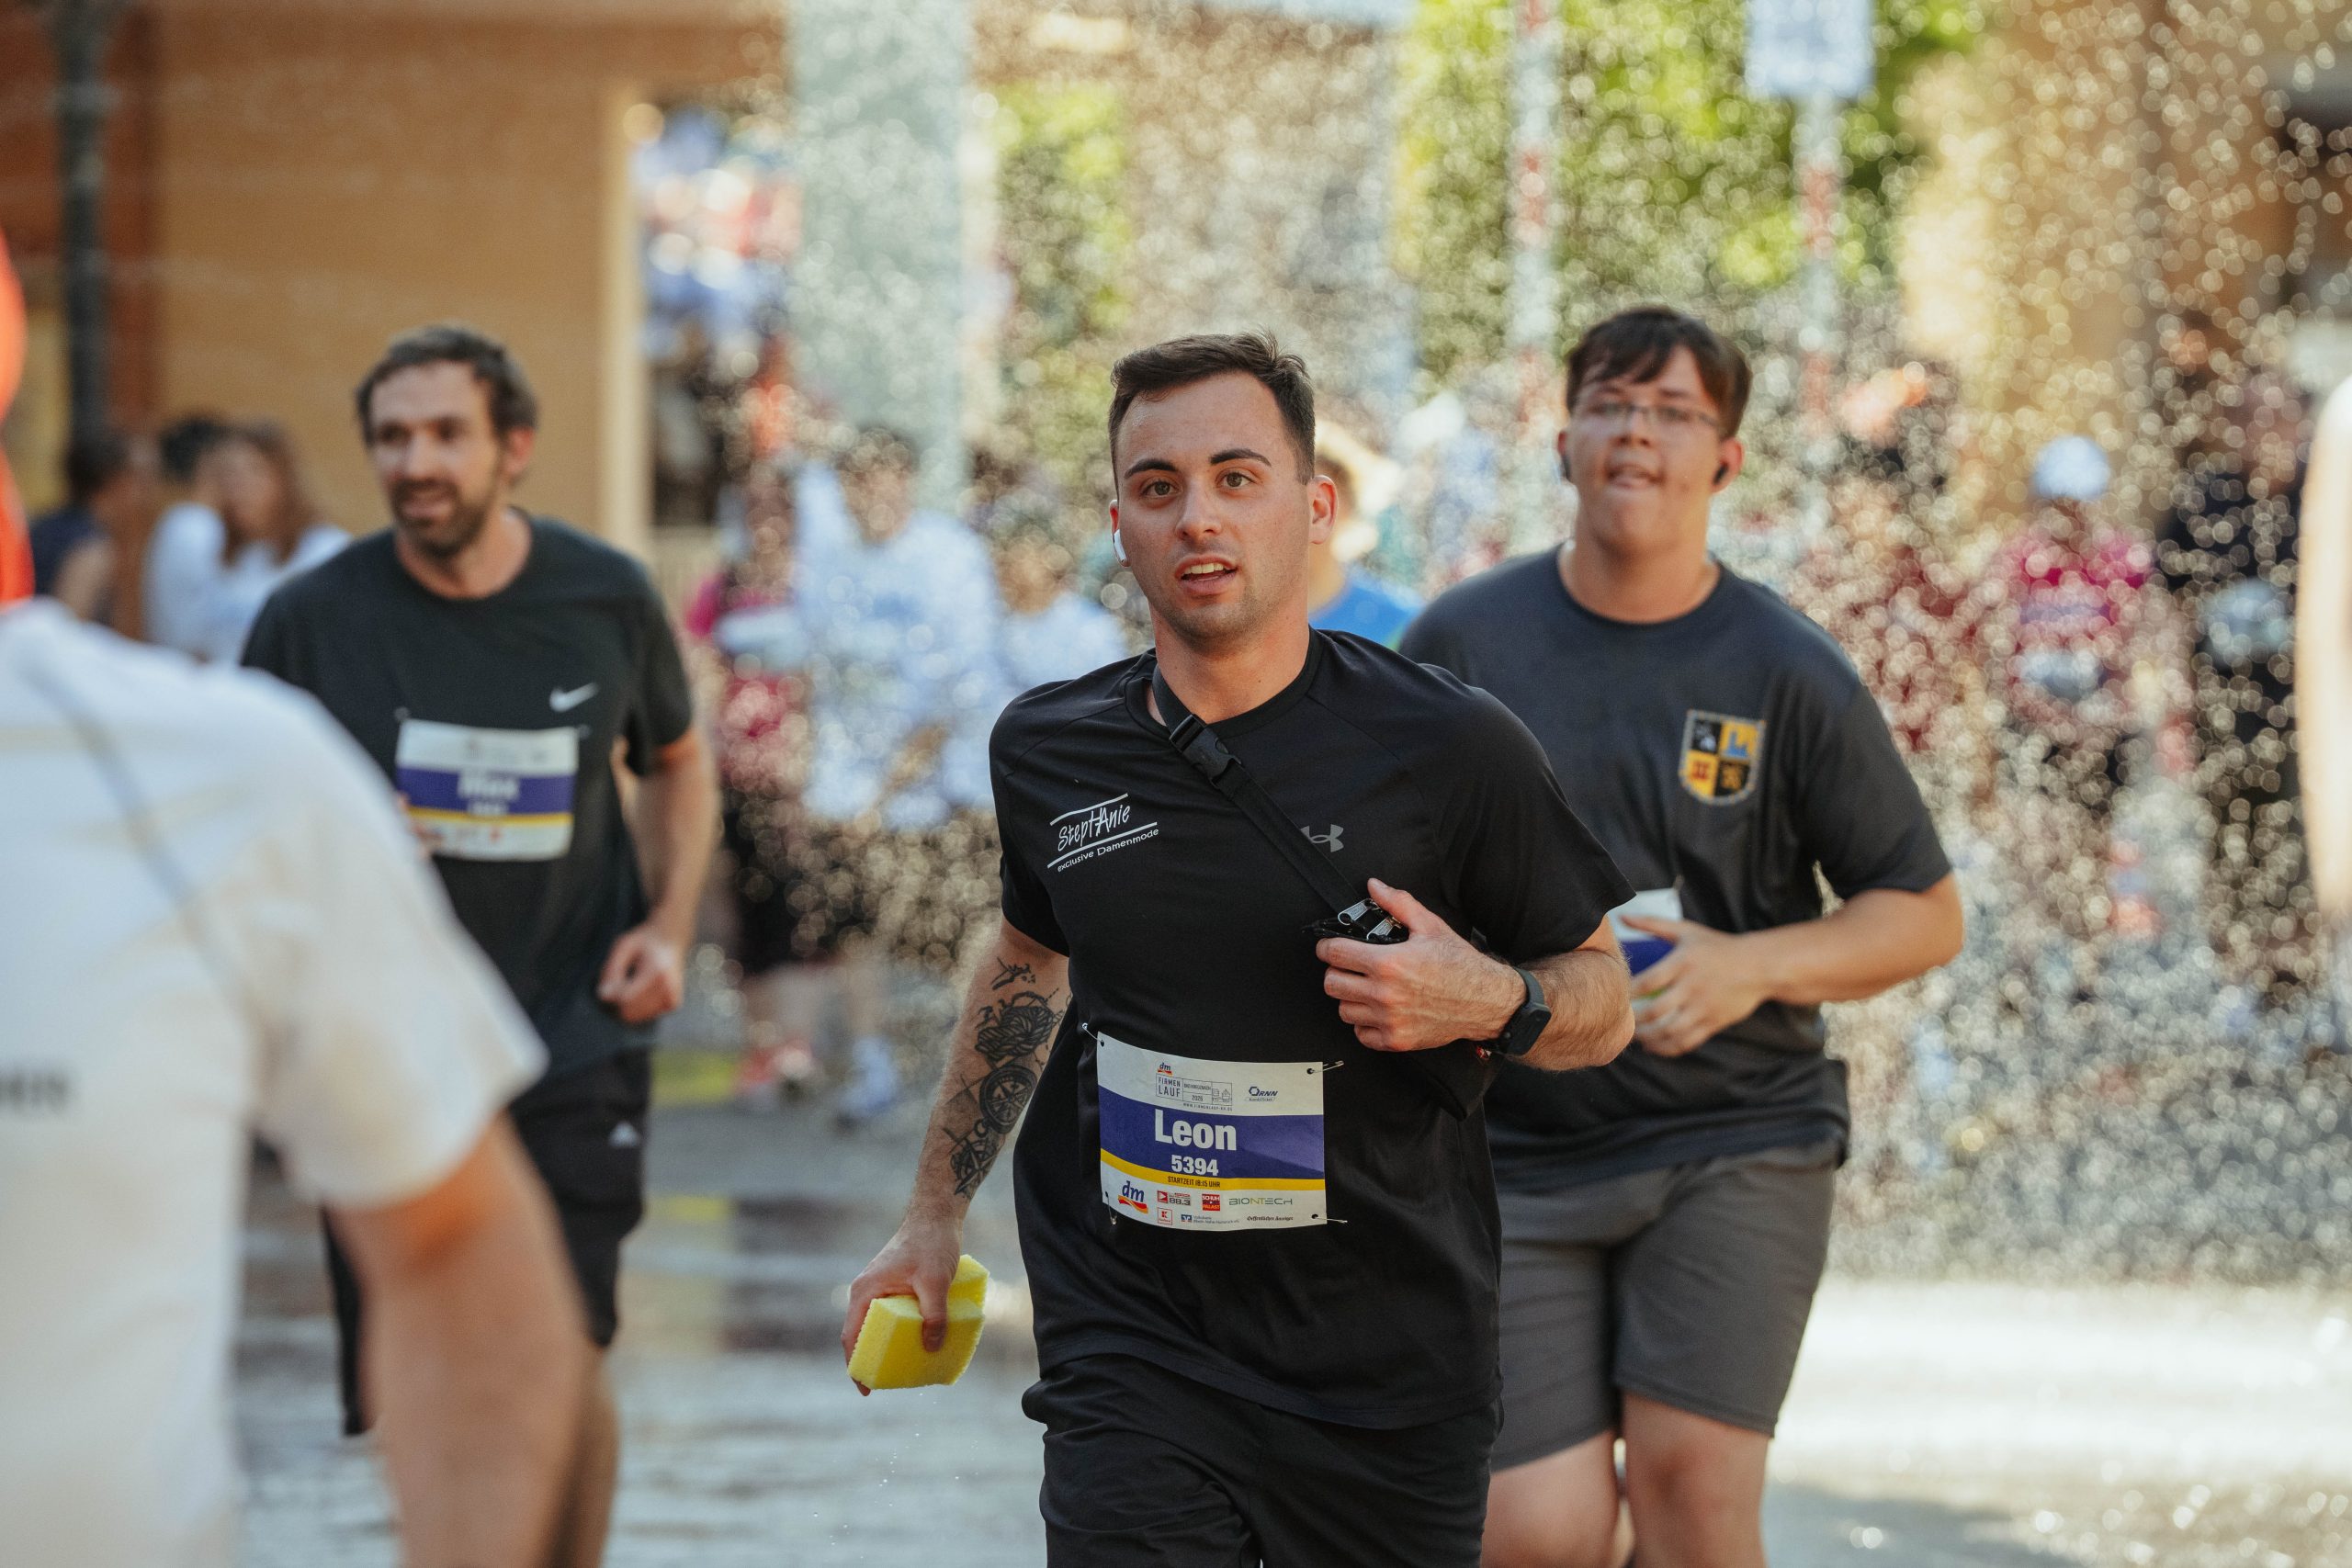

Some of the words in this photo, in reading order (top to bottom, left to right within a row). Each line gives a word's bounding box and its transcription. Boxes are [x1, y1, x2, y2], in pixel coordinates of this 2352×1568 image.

[1057, 850, 1094, 873] exclusive
[1097, 828, 1159, 856] Damenmode
[1159, 1062, 1171, 1071] dm
[1158, 1077, 1181, 1087] FIRMEN
[1158, 1085, 1181, 1098] LAUF
[1155, 1109, 1237, 1151] Leon
[1171, 1155, 1219, 1177] 5394
[1167, 1176, 1194, 1187] STARTZEIT
[1194, 1179, 1207, 1188] 18:15
[1208, 1180, 1221, 1189] UHR
[1122, 1180, 1145, 1202] dm
[1169, 1197, 1192, 1206] 88.3
